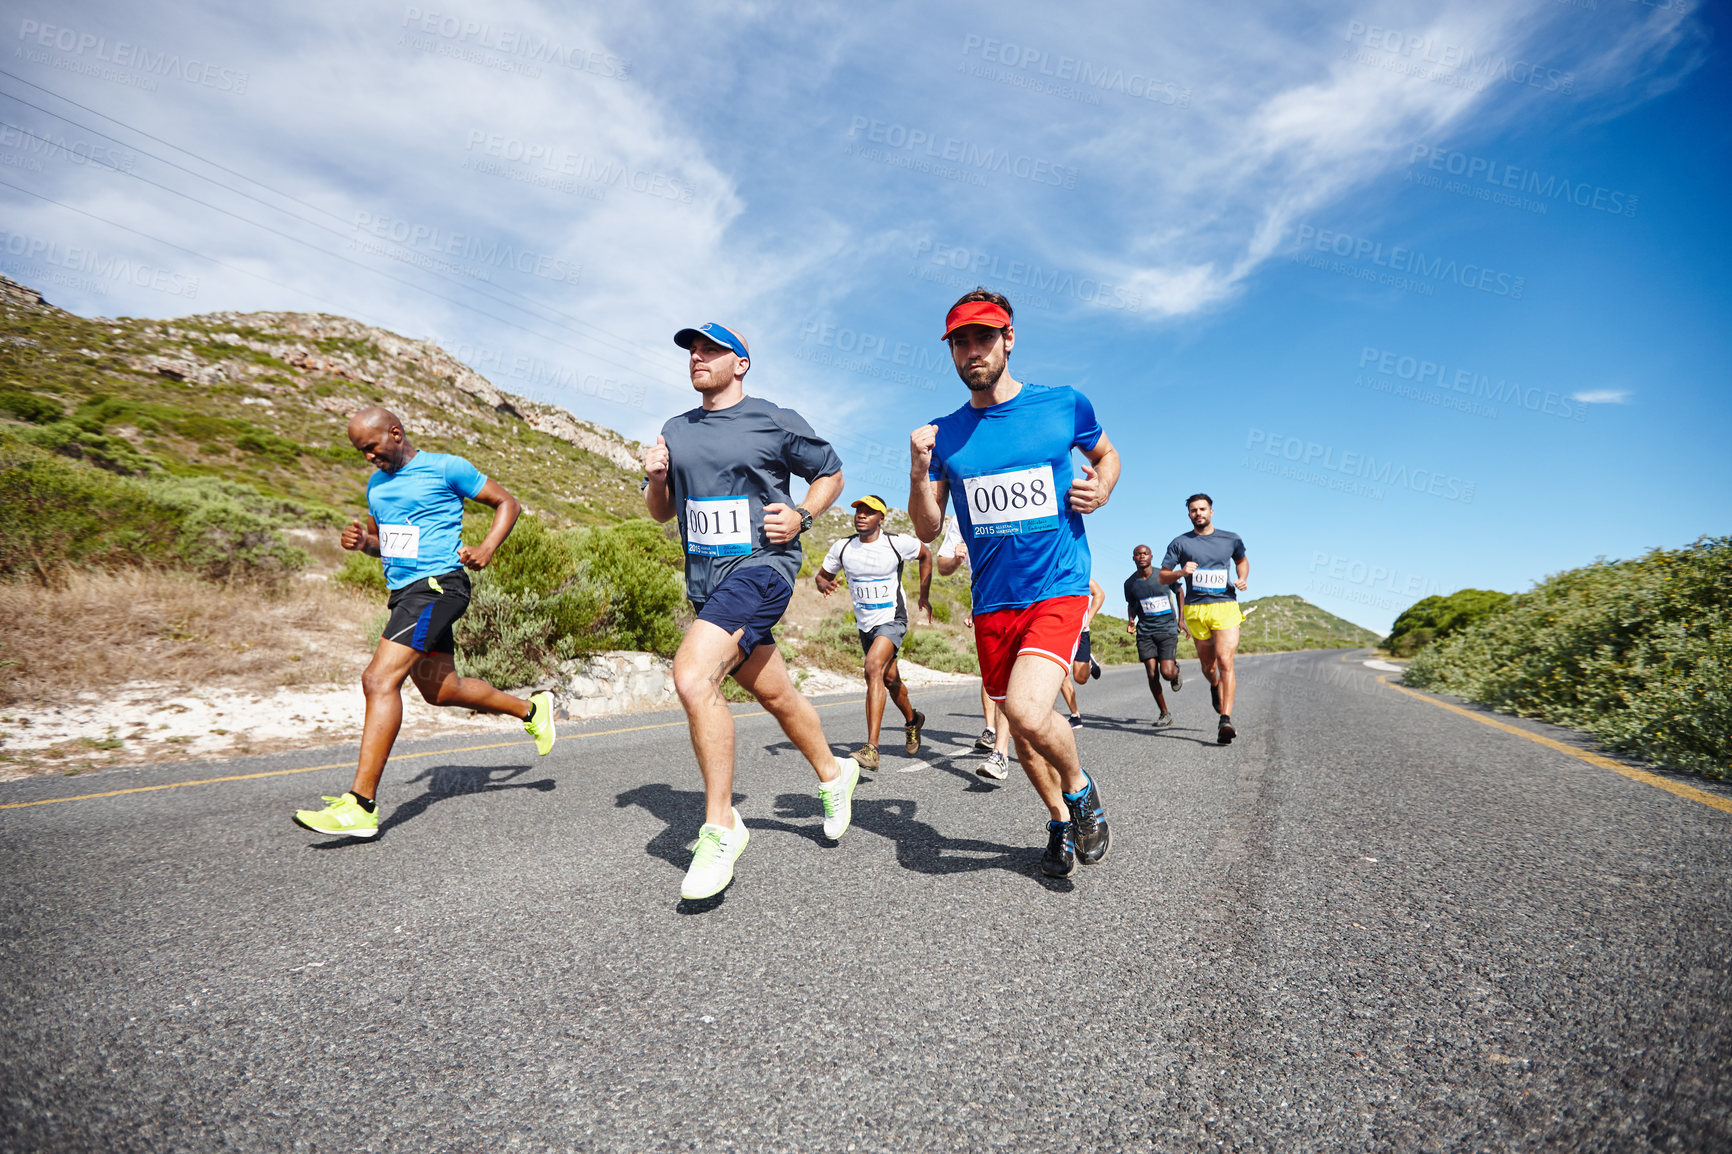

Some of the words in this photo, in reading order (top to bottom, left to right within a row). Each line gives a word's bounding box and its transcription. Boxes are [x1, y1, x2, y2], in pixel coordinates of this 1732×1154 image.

[974, 479, 1047, 514] 0088
[689, 509, 741, 535] 0011
[974, 526, 995, 536] 2015
[688, 543, 701, 554] 2015
[1195, 573, 1225, 584] 0108
[856, 585, 889, 599] 0112
